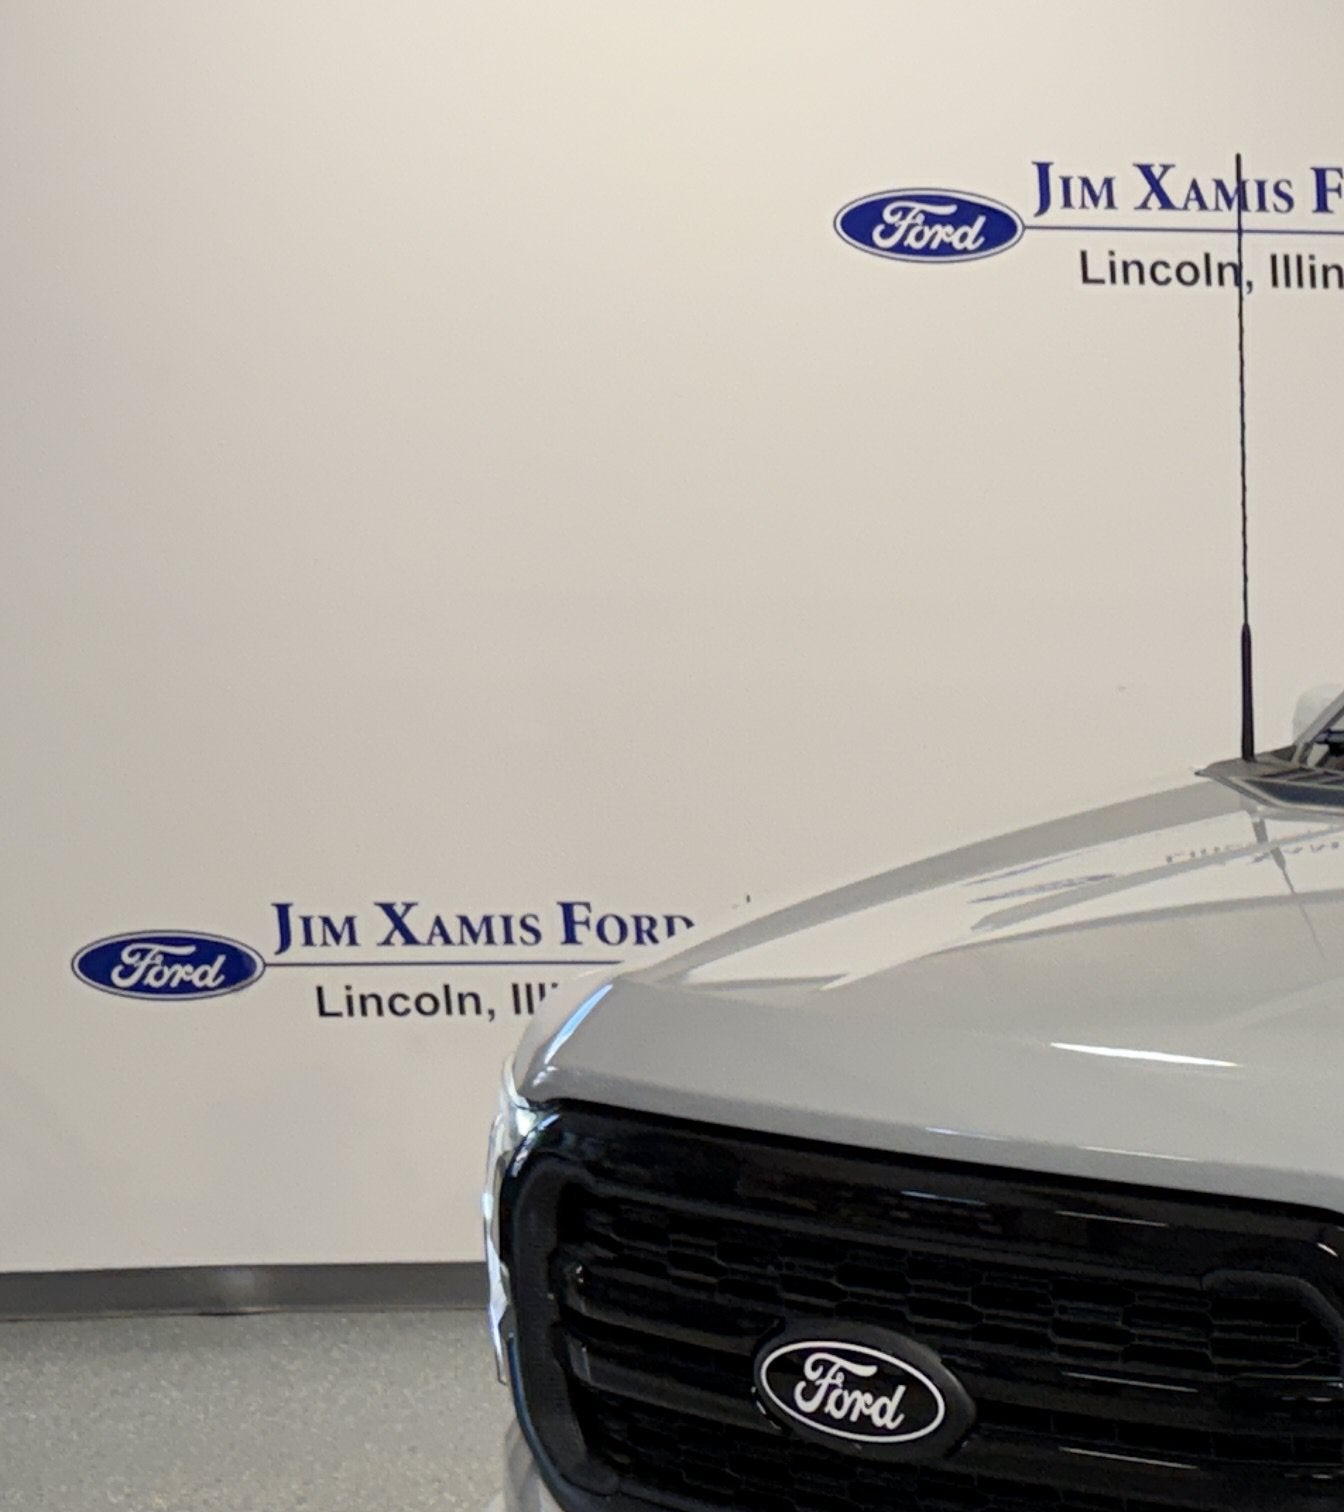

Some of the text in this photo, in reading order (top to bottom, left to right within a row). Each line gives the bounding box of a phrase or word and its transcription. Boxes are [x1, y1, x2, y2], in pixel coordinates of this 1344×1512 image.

[872, 200, 985, 252] Ford
[1080, 250, 1254, 295] Lincoln,
[110, 942, 225, 989] Ford
[315, 983, 495, 1022] Lincoln,
[793, 1352, 906, 1431] Ford
